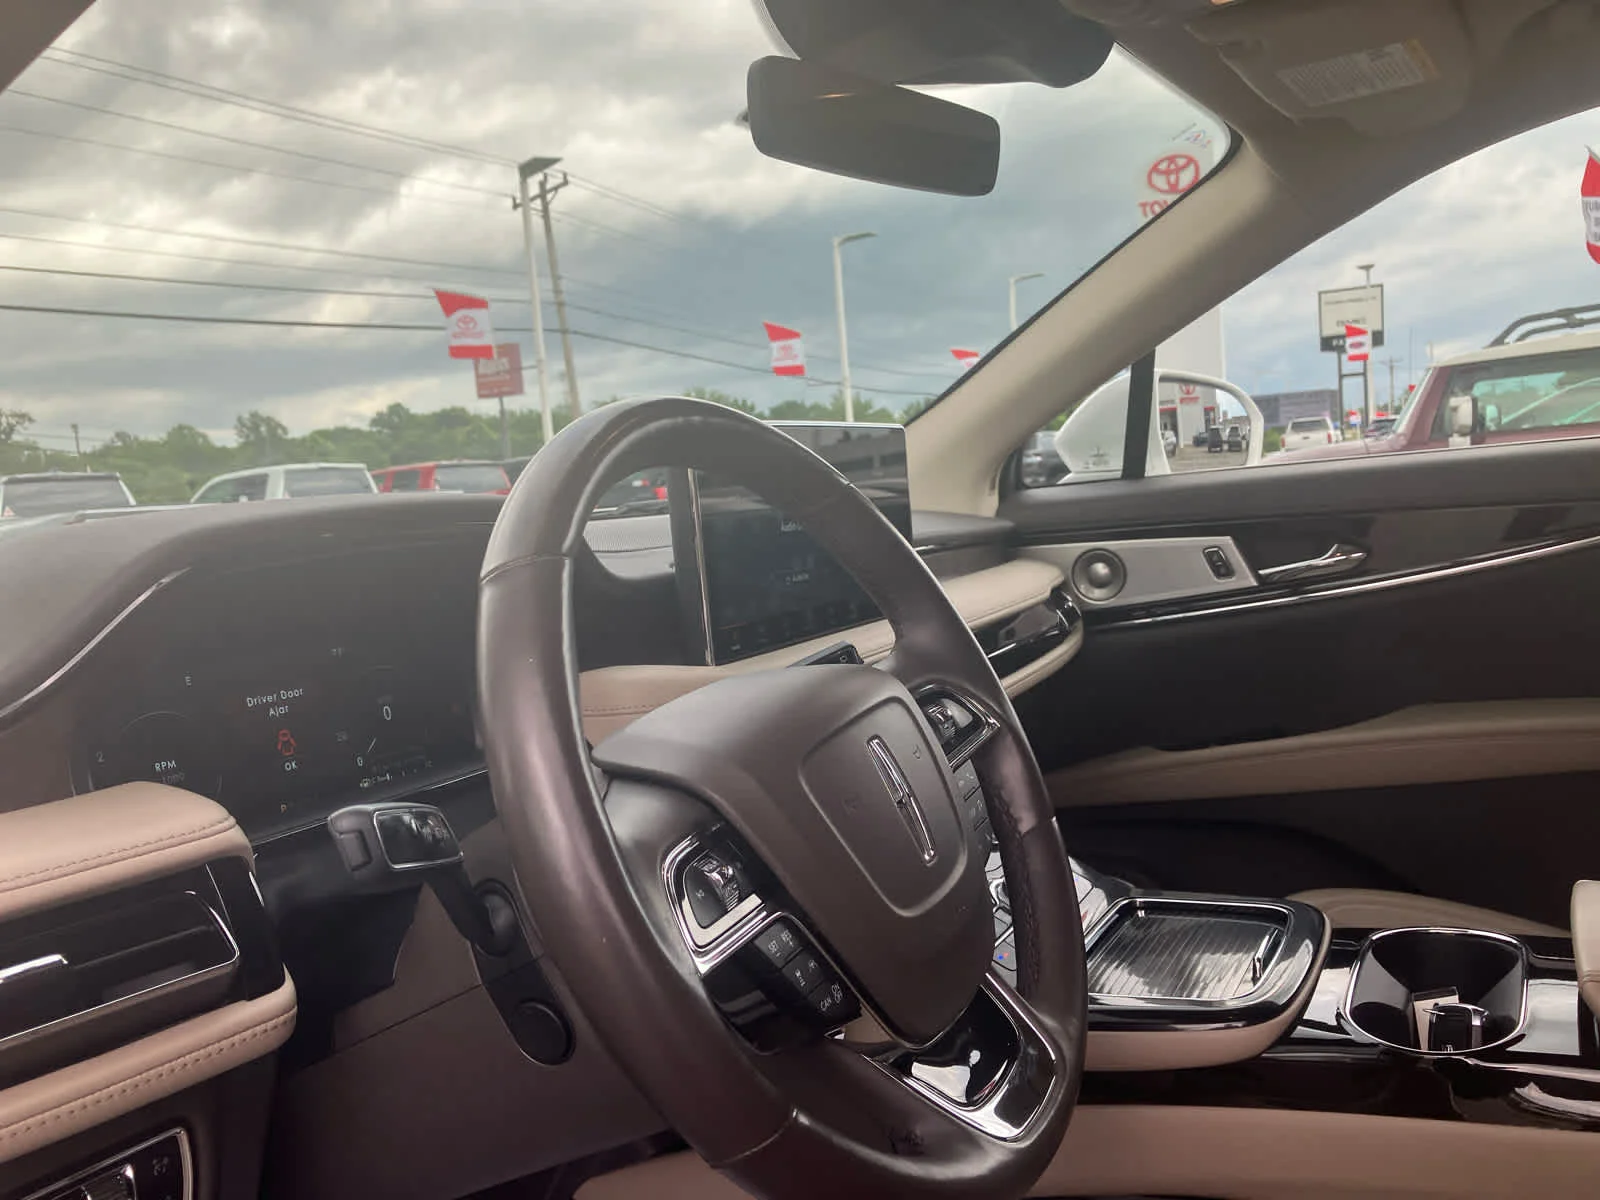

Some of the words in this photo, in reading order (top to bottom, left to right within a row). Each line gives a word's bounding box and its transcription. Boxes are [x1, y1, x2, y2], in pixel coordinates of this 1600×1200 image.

[1138, 199, 1169, 218] TO
[246, 693, 277, 708] Driver
[279, 687, 304, 700] Door
[268, 704, 289, 718] Ajar
[383, 705, 392, 721] 0
[154, 759, 177, 773] RPM
[284, 760, 297, 772] OK
